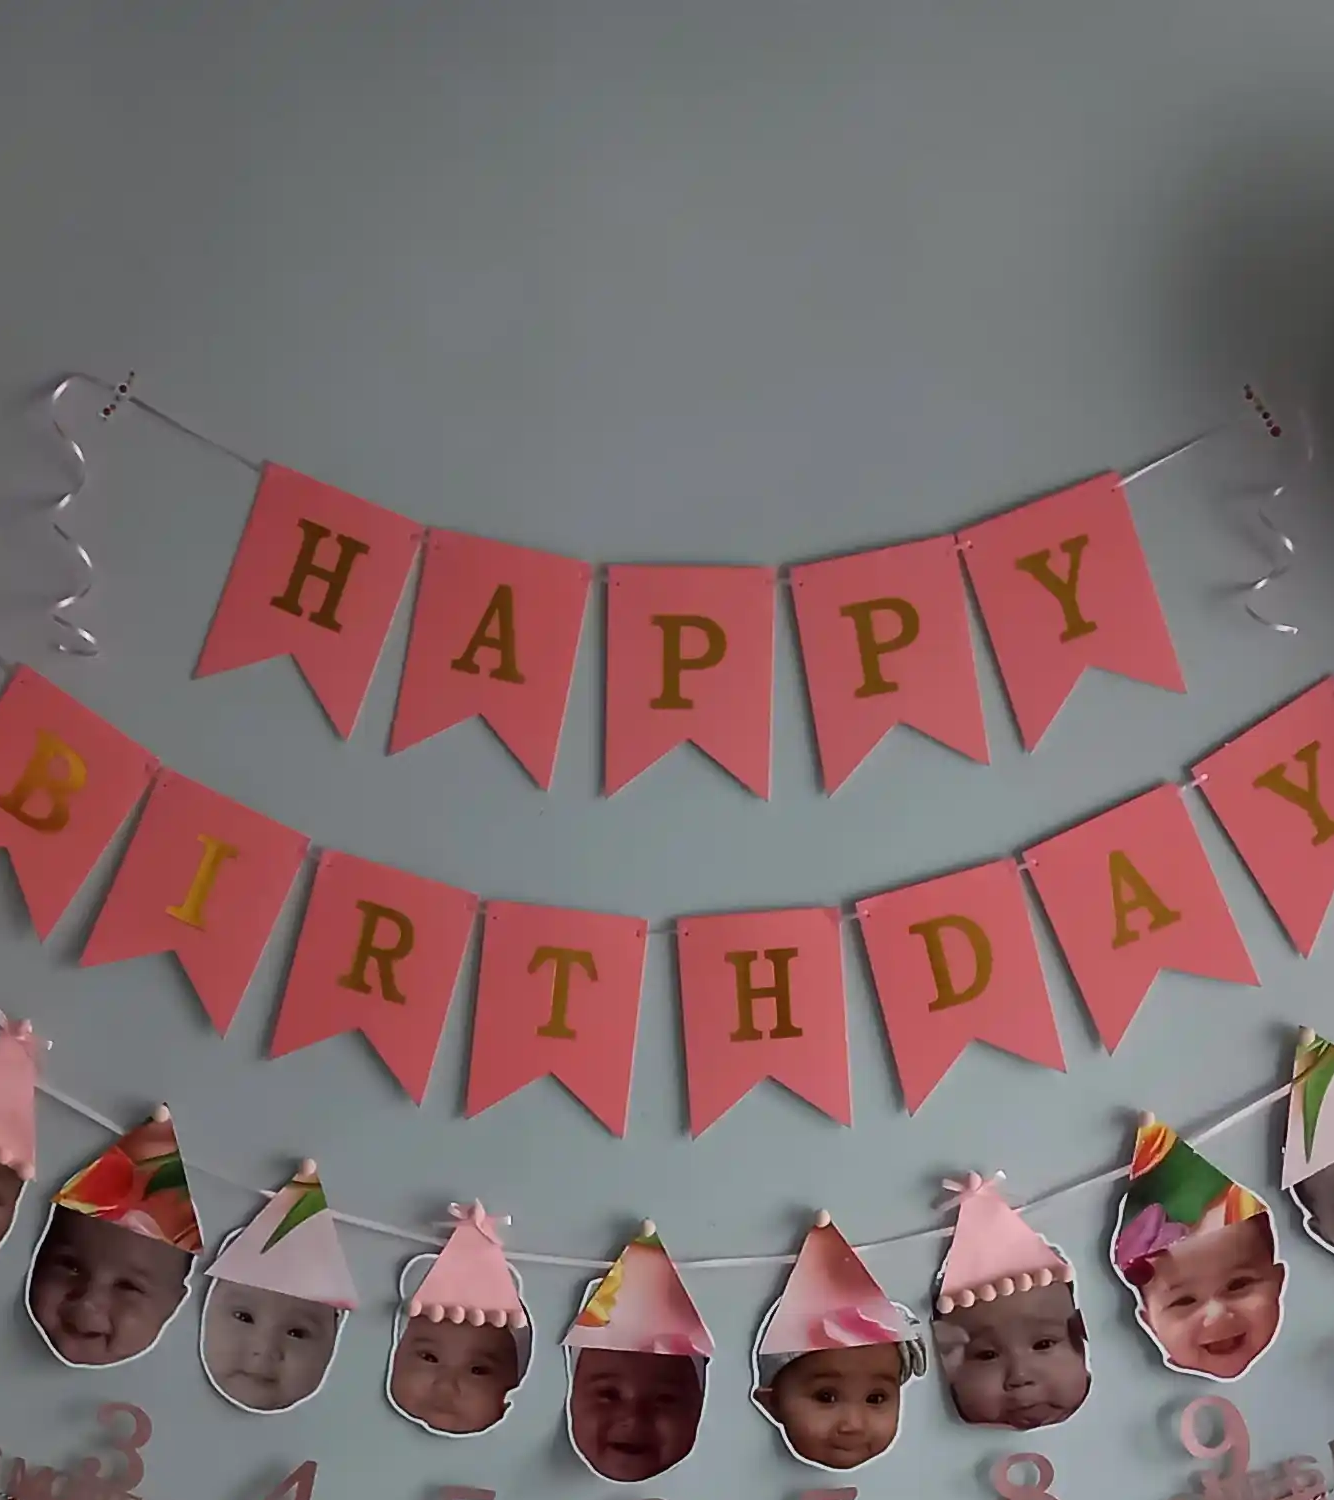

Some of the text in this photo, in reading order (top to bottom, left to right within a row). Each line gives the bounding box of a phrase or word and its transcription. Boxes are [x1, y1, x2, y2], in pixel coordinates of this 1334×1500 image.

[270, 518, 1091, 711] HAPPY
[82, 1402, 153, 1495] 3
[1179, 1395, 1251, 1495] 9
